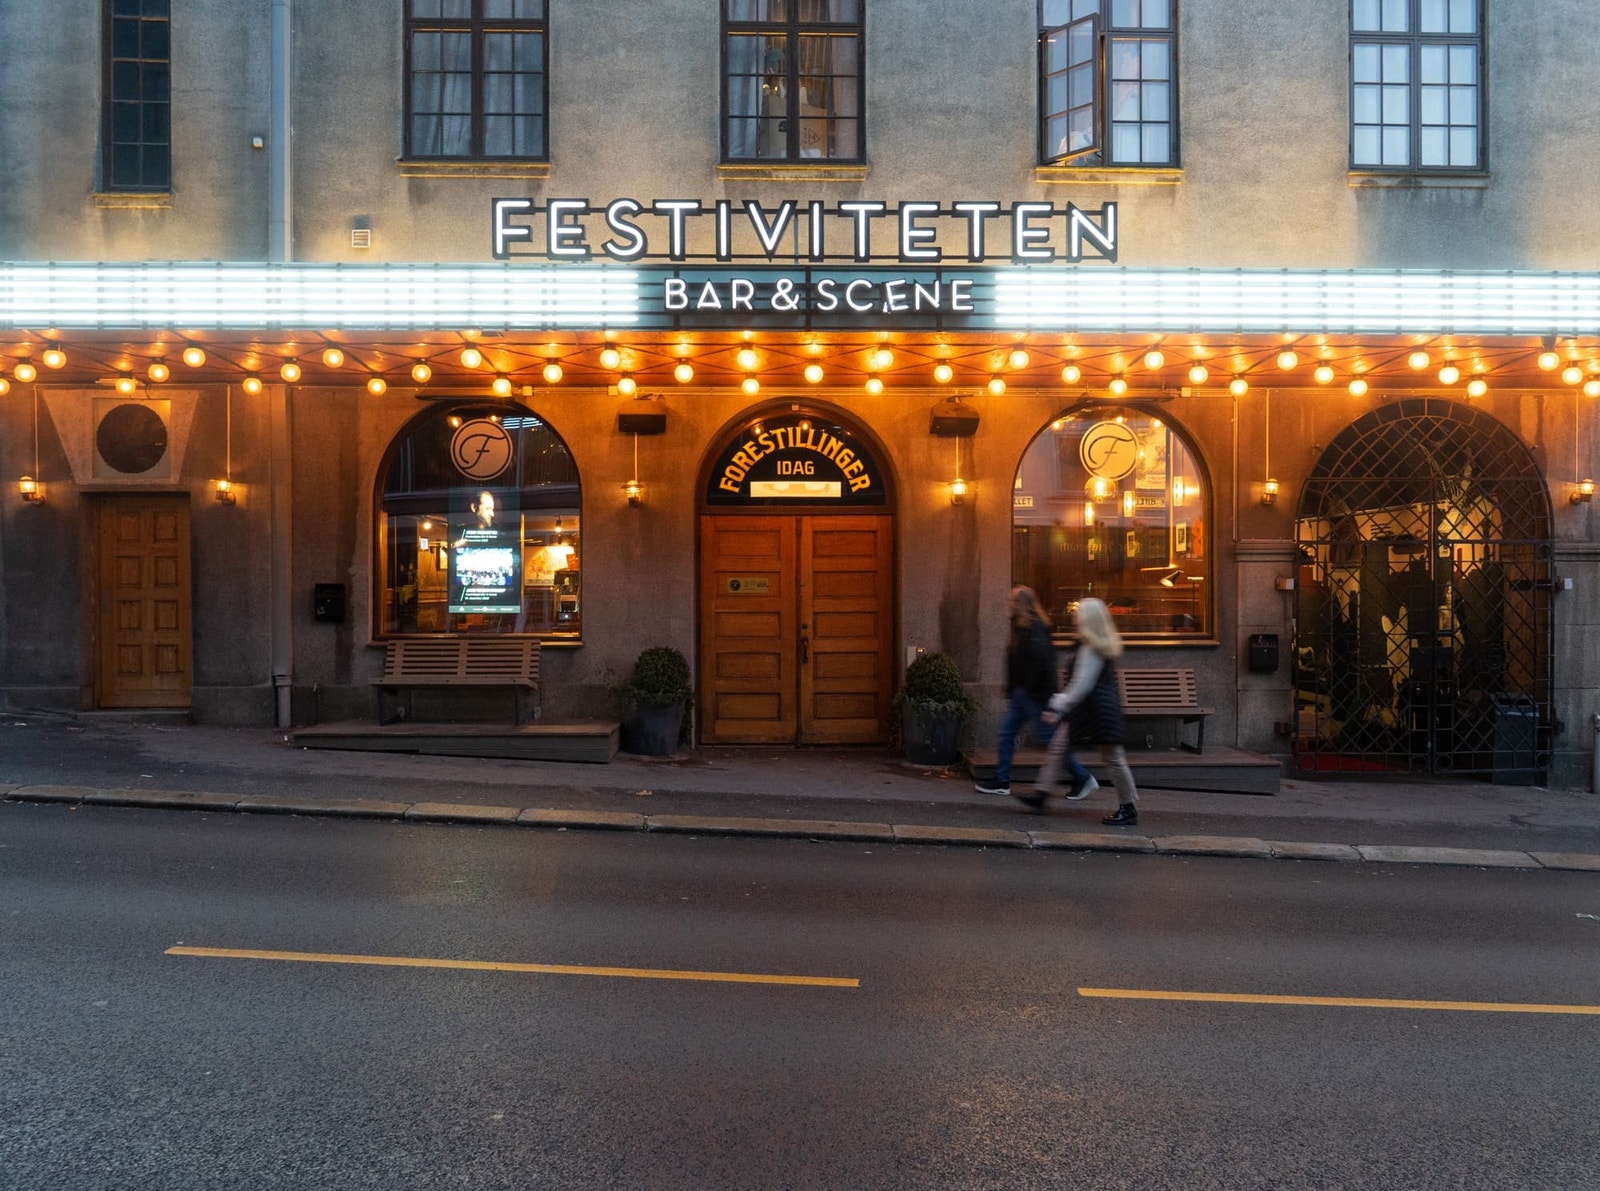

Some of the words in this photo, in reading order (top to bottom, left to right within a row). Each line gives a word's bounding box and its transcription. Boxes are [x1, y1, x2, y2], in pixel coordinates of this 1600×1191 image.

[492, 198, 1118, 264] FESTIVITETEN
[664, 278, 754, 310] BAR
[770, 278, 800, 311] &
[816, 278, 975, 313] SCENE
[719, 426, 871, 493] FORESTILLINGER
[777, 460, 815, 475] IDAG
